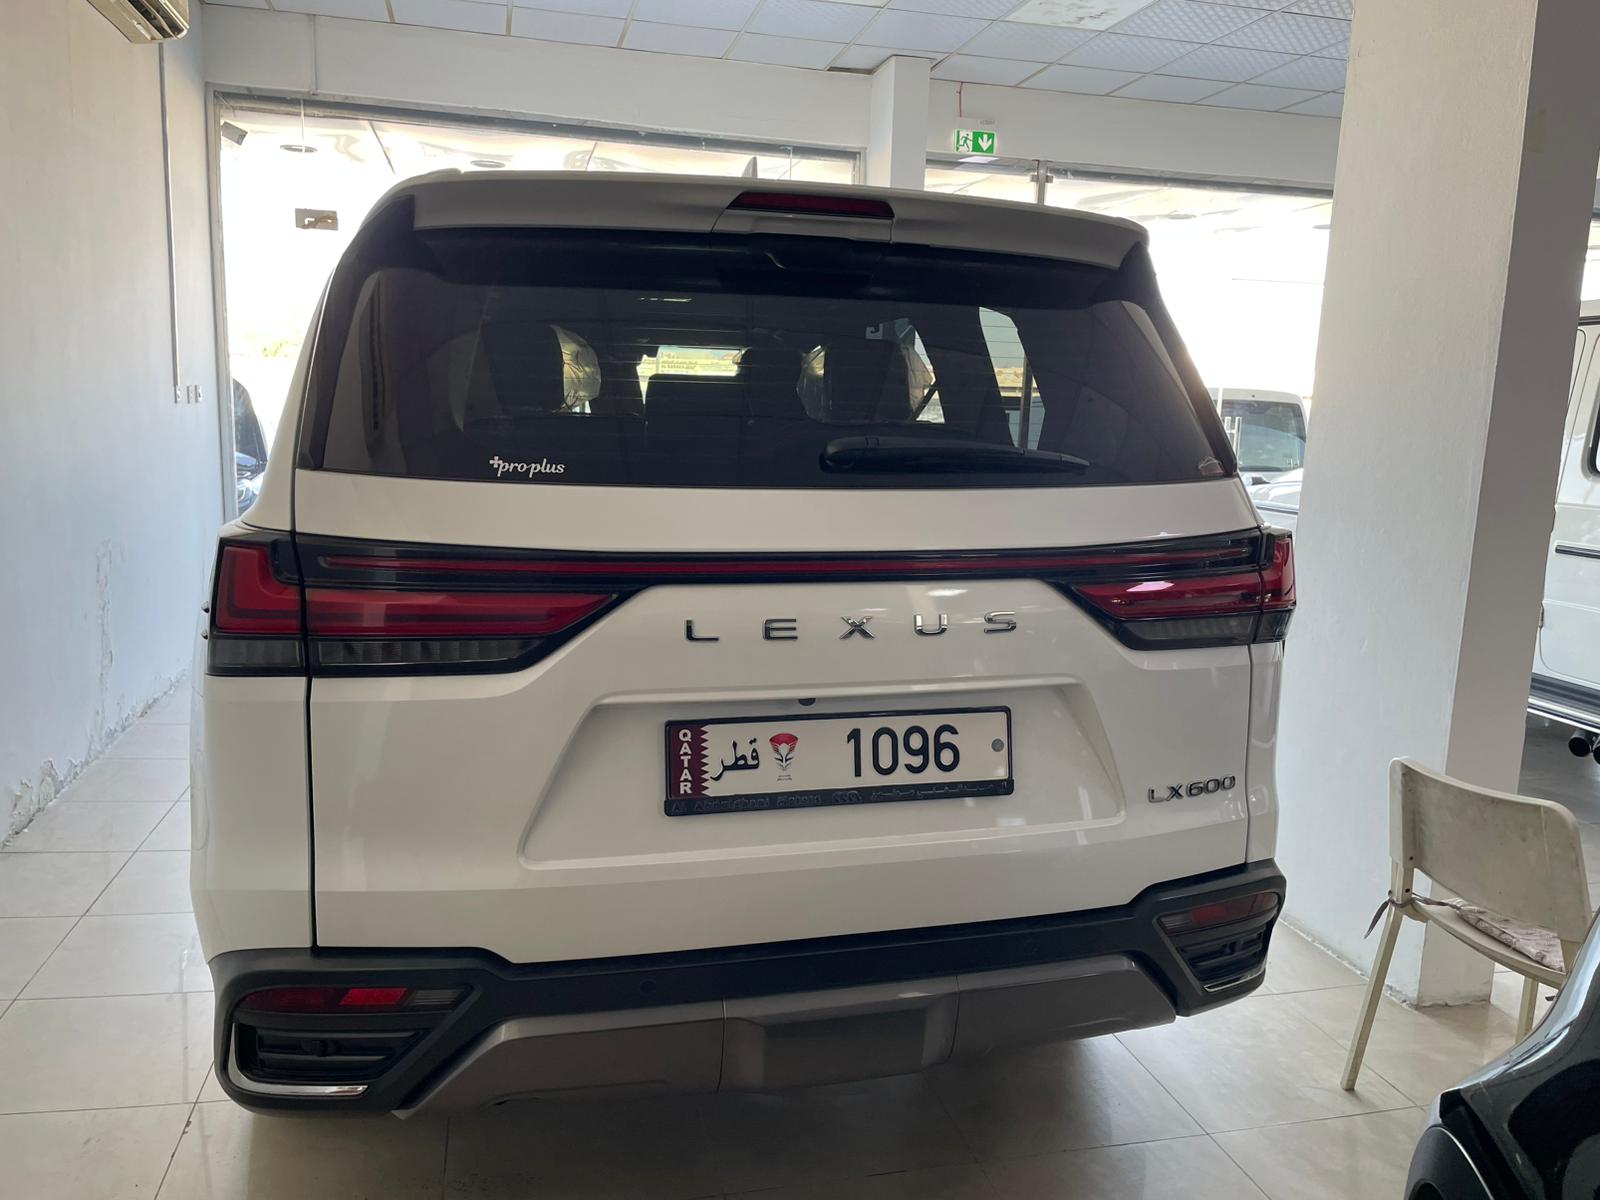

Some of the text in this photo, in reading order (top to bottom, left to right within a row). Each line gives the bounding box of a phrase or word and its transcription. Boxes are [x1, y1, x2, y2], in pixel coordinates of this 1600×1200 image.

[684, 610, 1017, 642] LEXUS
[678, 728, 693, 794] QATAR
[710, 737, 760, 781] قطر
[846, 724, 960, 777] 1096
